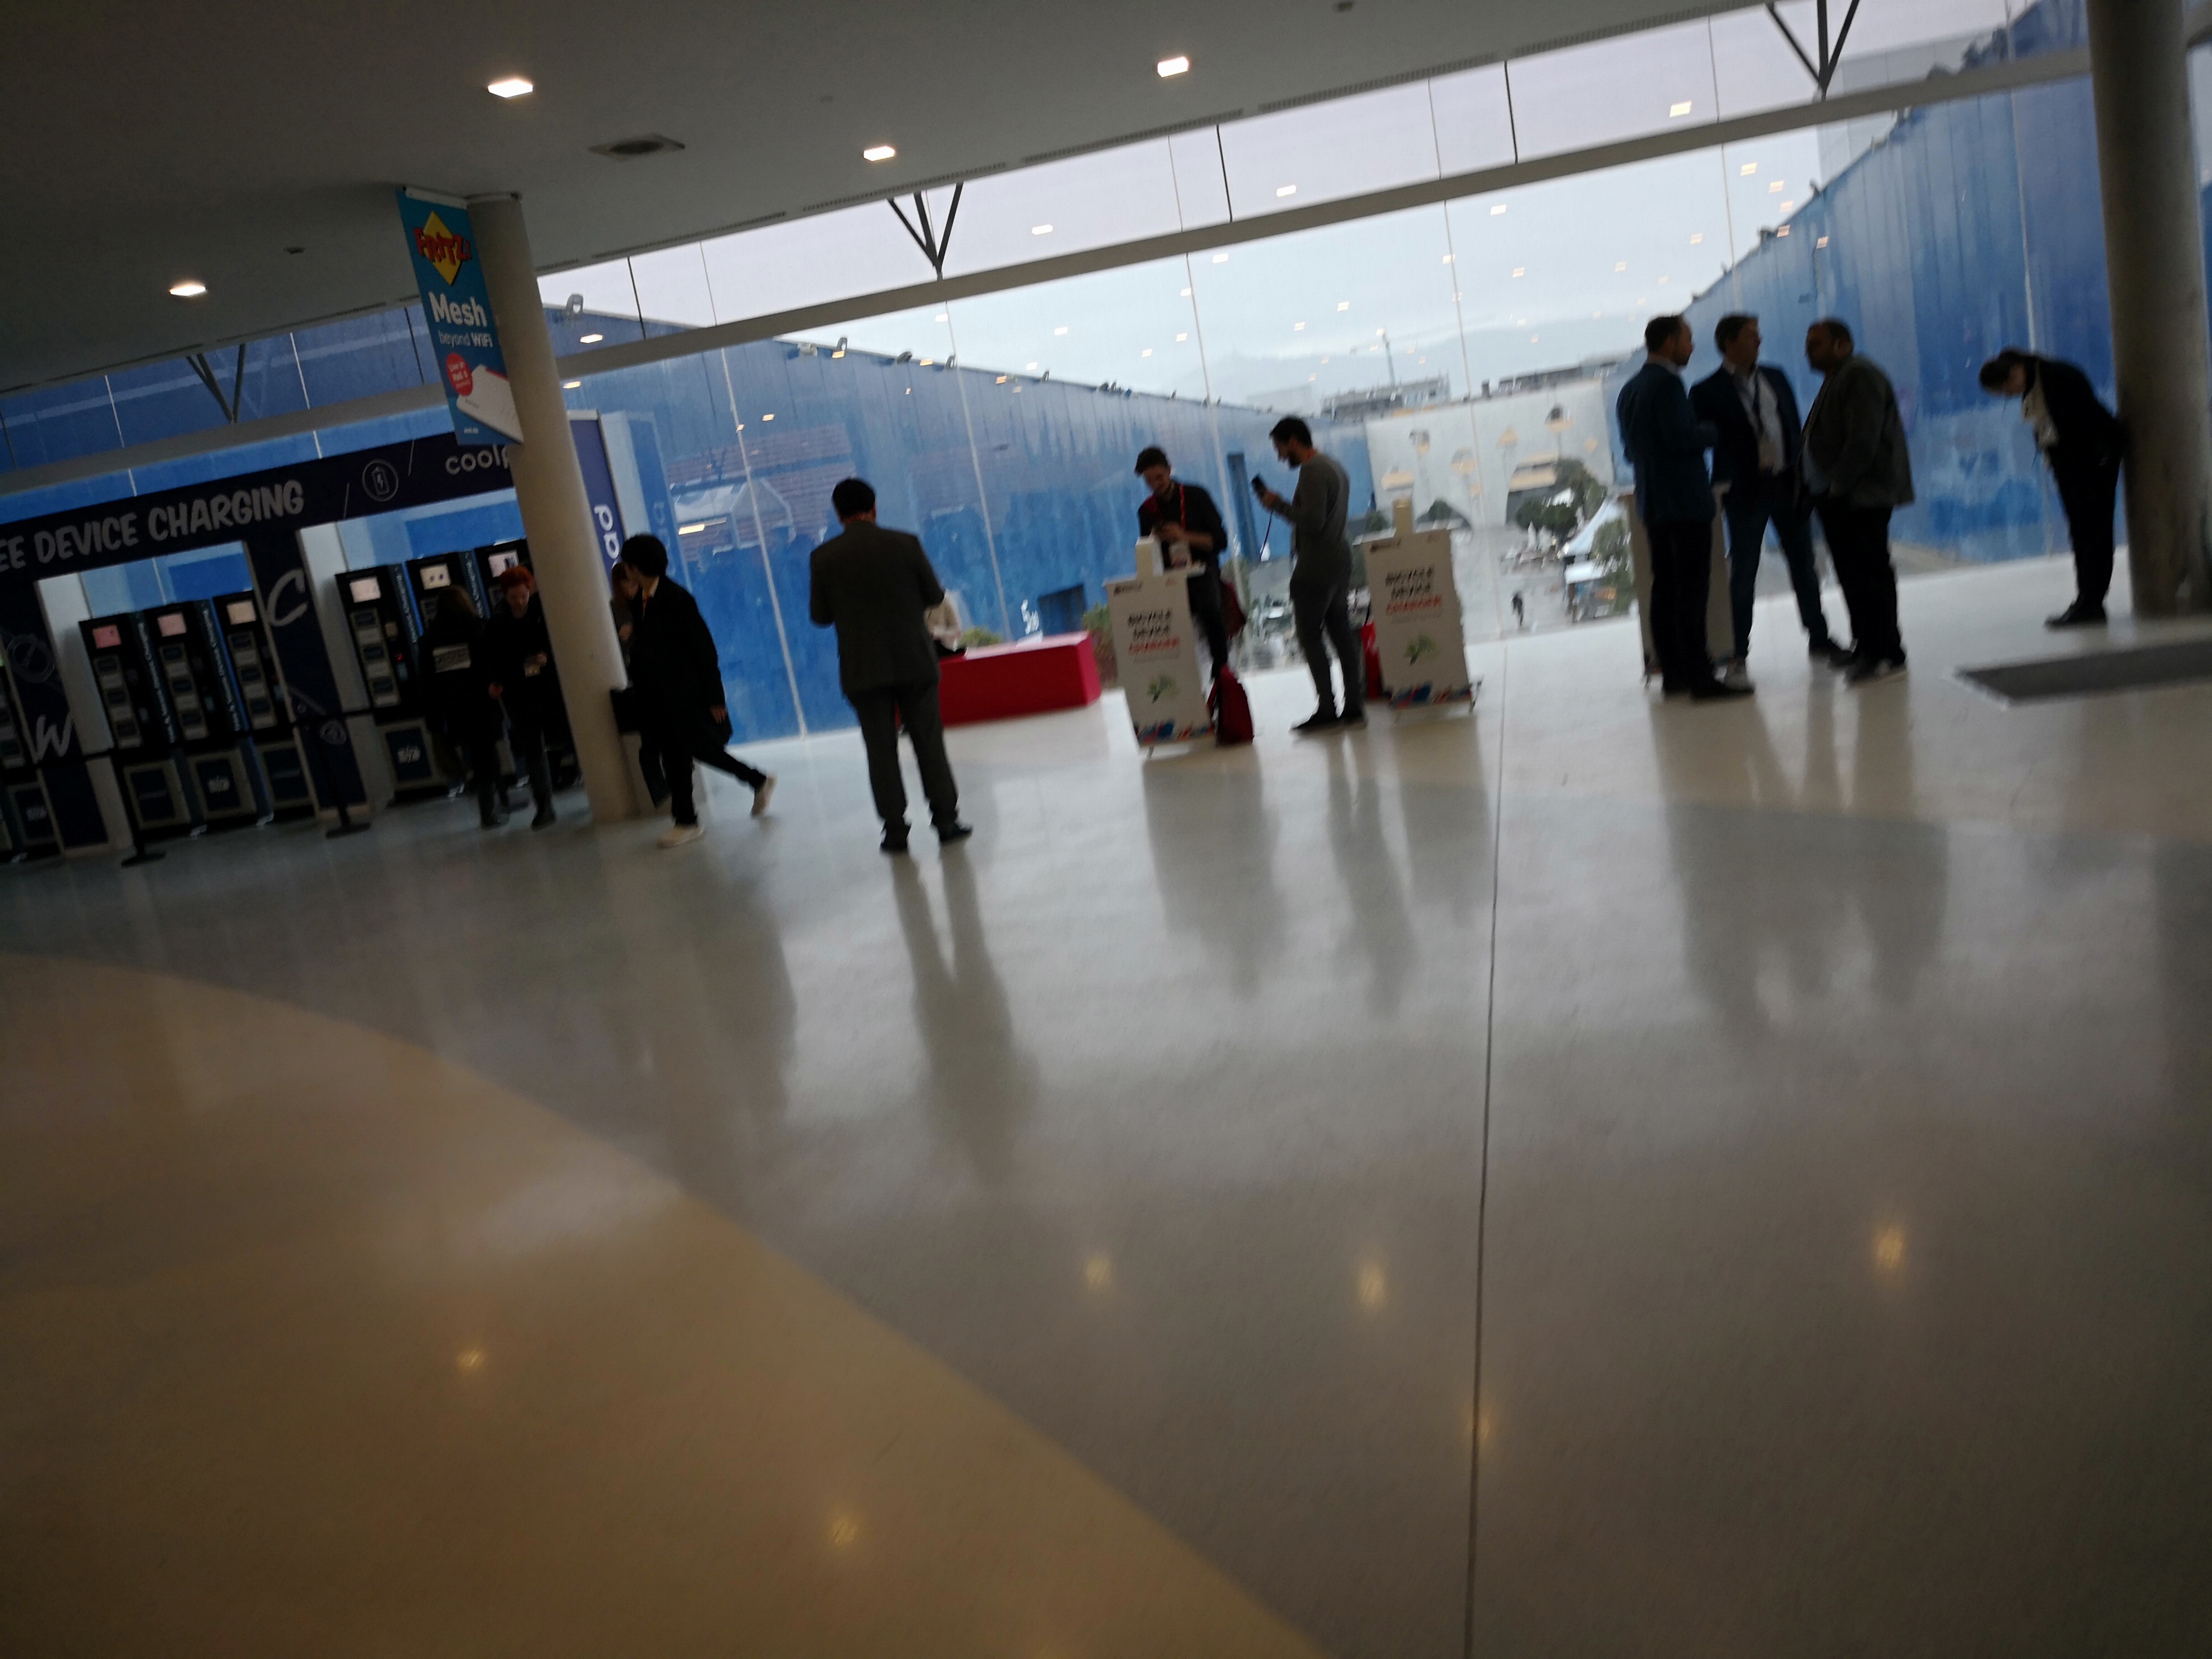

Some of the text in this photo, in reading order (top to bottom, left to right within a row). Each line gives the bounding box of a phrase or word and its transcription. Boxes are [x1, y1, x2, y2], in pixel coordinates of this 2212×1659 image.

[428, 291, 487, 327] Mesh
[438, 329, 470, 348] beyond
[34, 512, 139, 564] DEVICE
[148, 479, 305, 541] CHARGING
